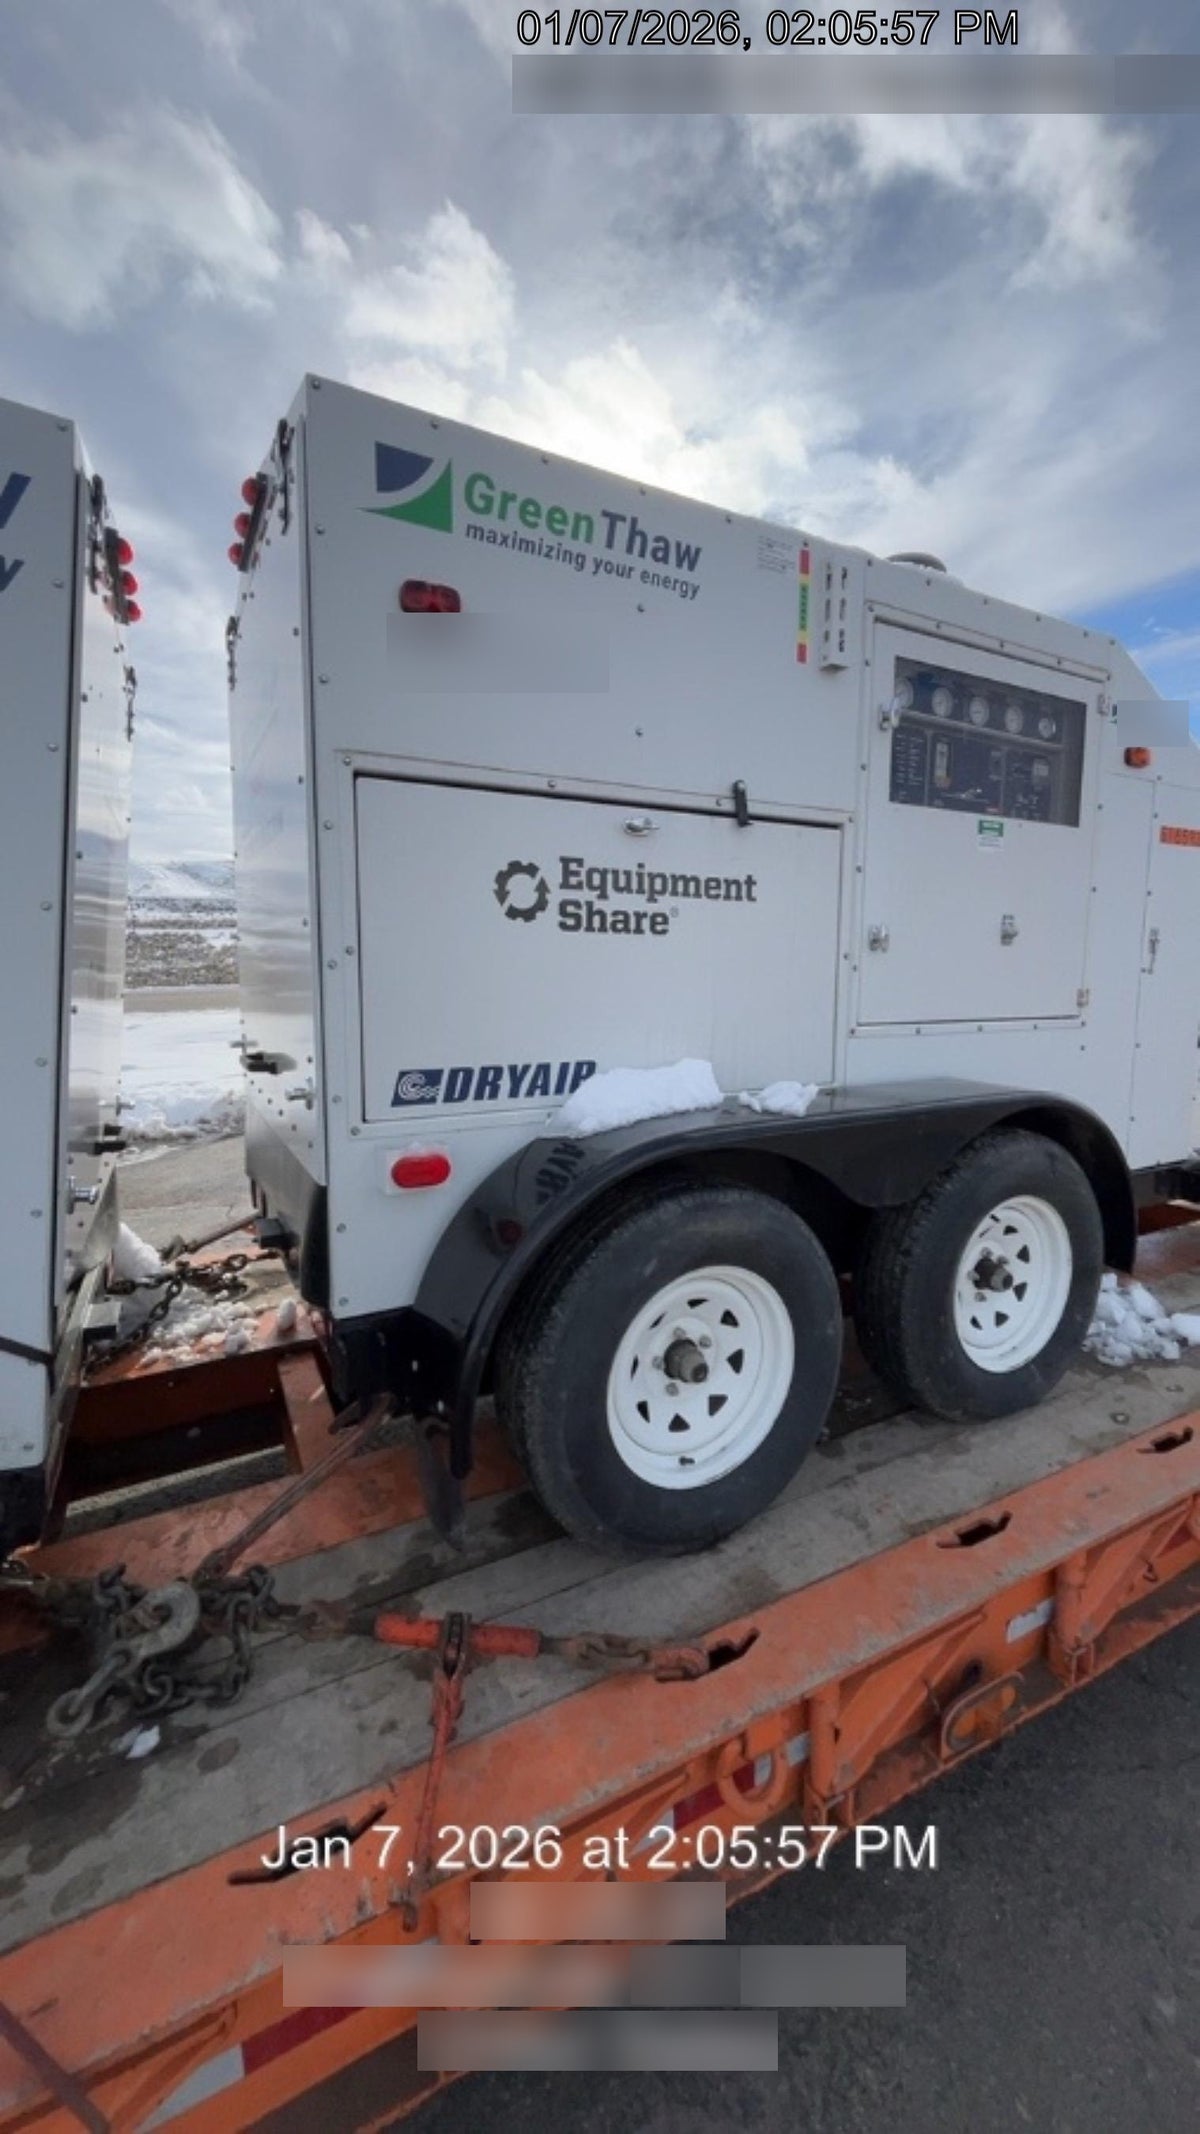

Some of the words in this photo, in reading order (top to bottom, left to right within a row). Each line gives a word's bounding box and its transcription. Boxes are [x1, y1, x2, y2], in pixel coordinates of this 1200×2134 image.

[466, 523, 586, 572] maximizing
[592, 555, 635, 576] your
[640, 569, 700, 600] energy
[559, 856, 757, 903] Equipment
